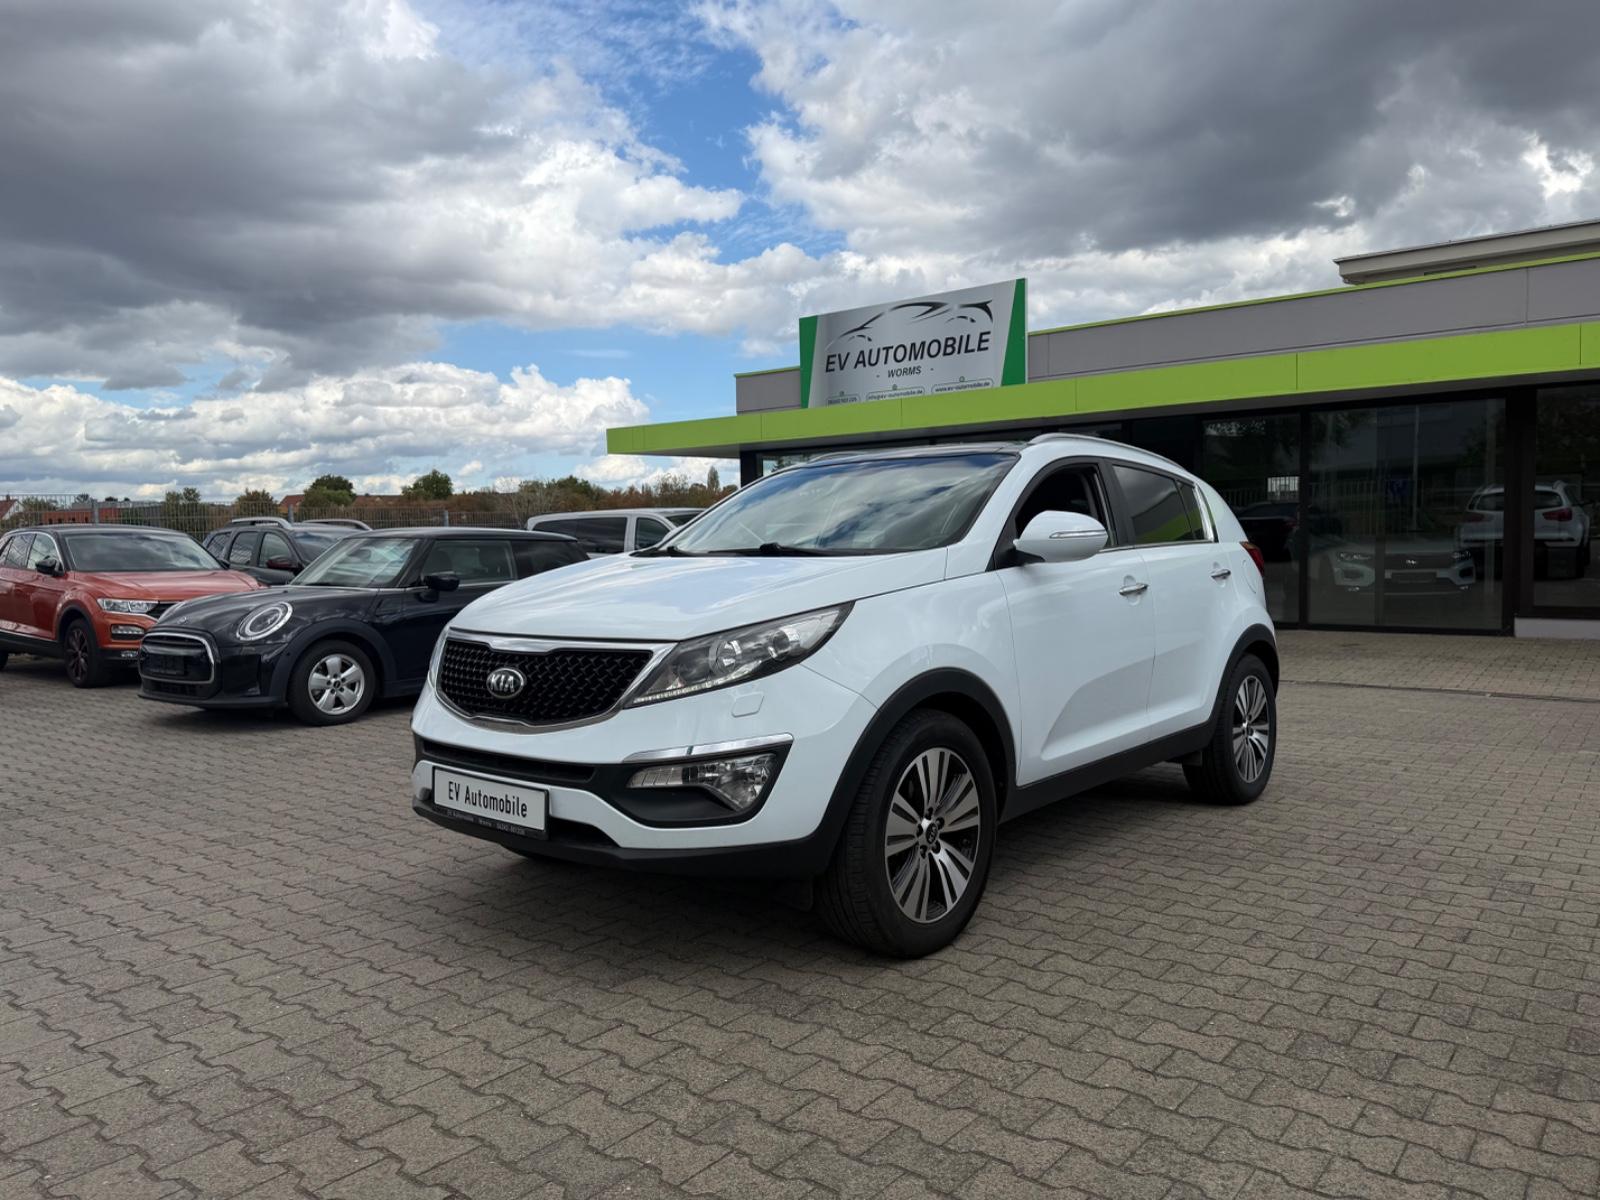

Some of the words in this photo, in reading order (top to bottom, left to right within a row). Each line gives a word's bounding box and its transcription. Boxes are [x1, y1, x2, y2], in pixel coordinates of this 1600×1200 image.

[825, 351, 850, 373] EV
[854, 331, 992, 370] AUTOMOBILE
[887, 365, 922, 378] WORMS
[448, 781, 460, 801] EV
[465, 785, 528, 818] Automobile
